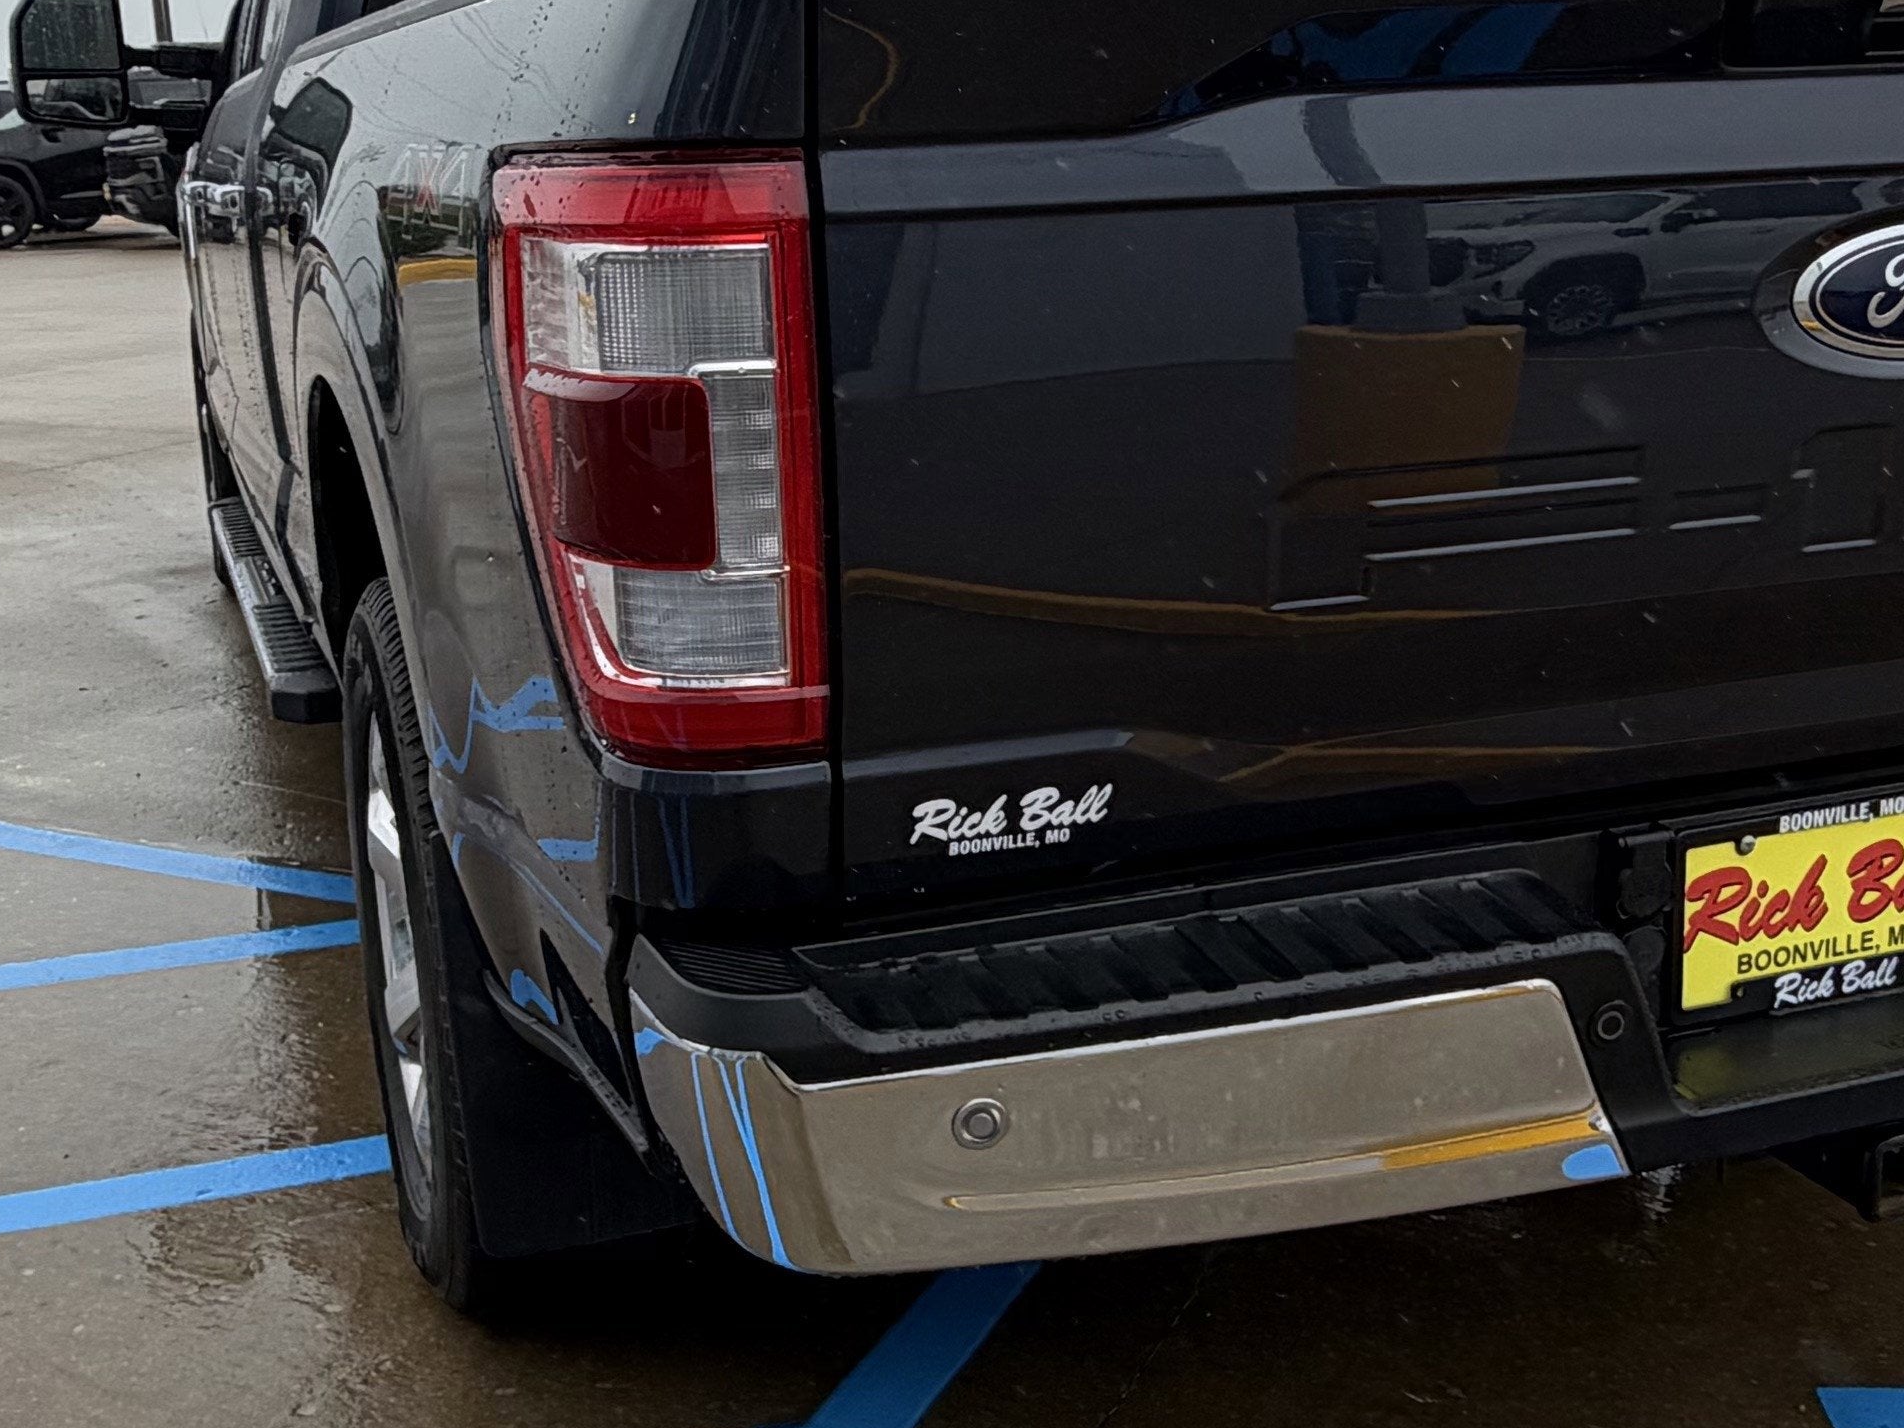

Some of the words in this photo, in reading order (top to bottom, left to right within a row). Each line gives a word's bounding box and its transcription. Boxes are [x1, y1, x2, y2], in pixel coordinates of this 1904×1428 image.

[910, 794, 1008, 845] Rick
[1019, 783, 1113, 831] Ball
[1779, 803, 1874, 833] BOONVILLE,
[948, 832, 1040, 856] BOONVILLE,
[1045, 828, 1071, 845] MO
[1683, 853, 1829, 954] Rick
[1737, 930, 1880, 974] BOONVILLE,
[1774, 966, 1835, 1009] Rick
[1841, 957, 1900, 994] Ball
